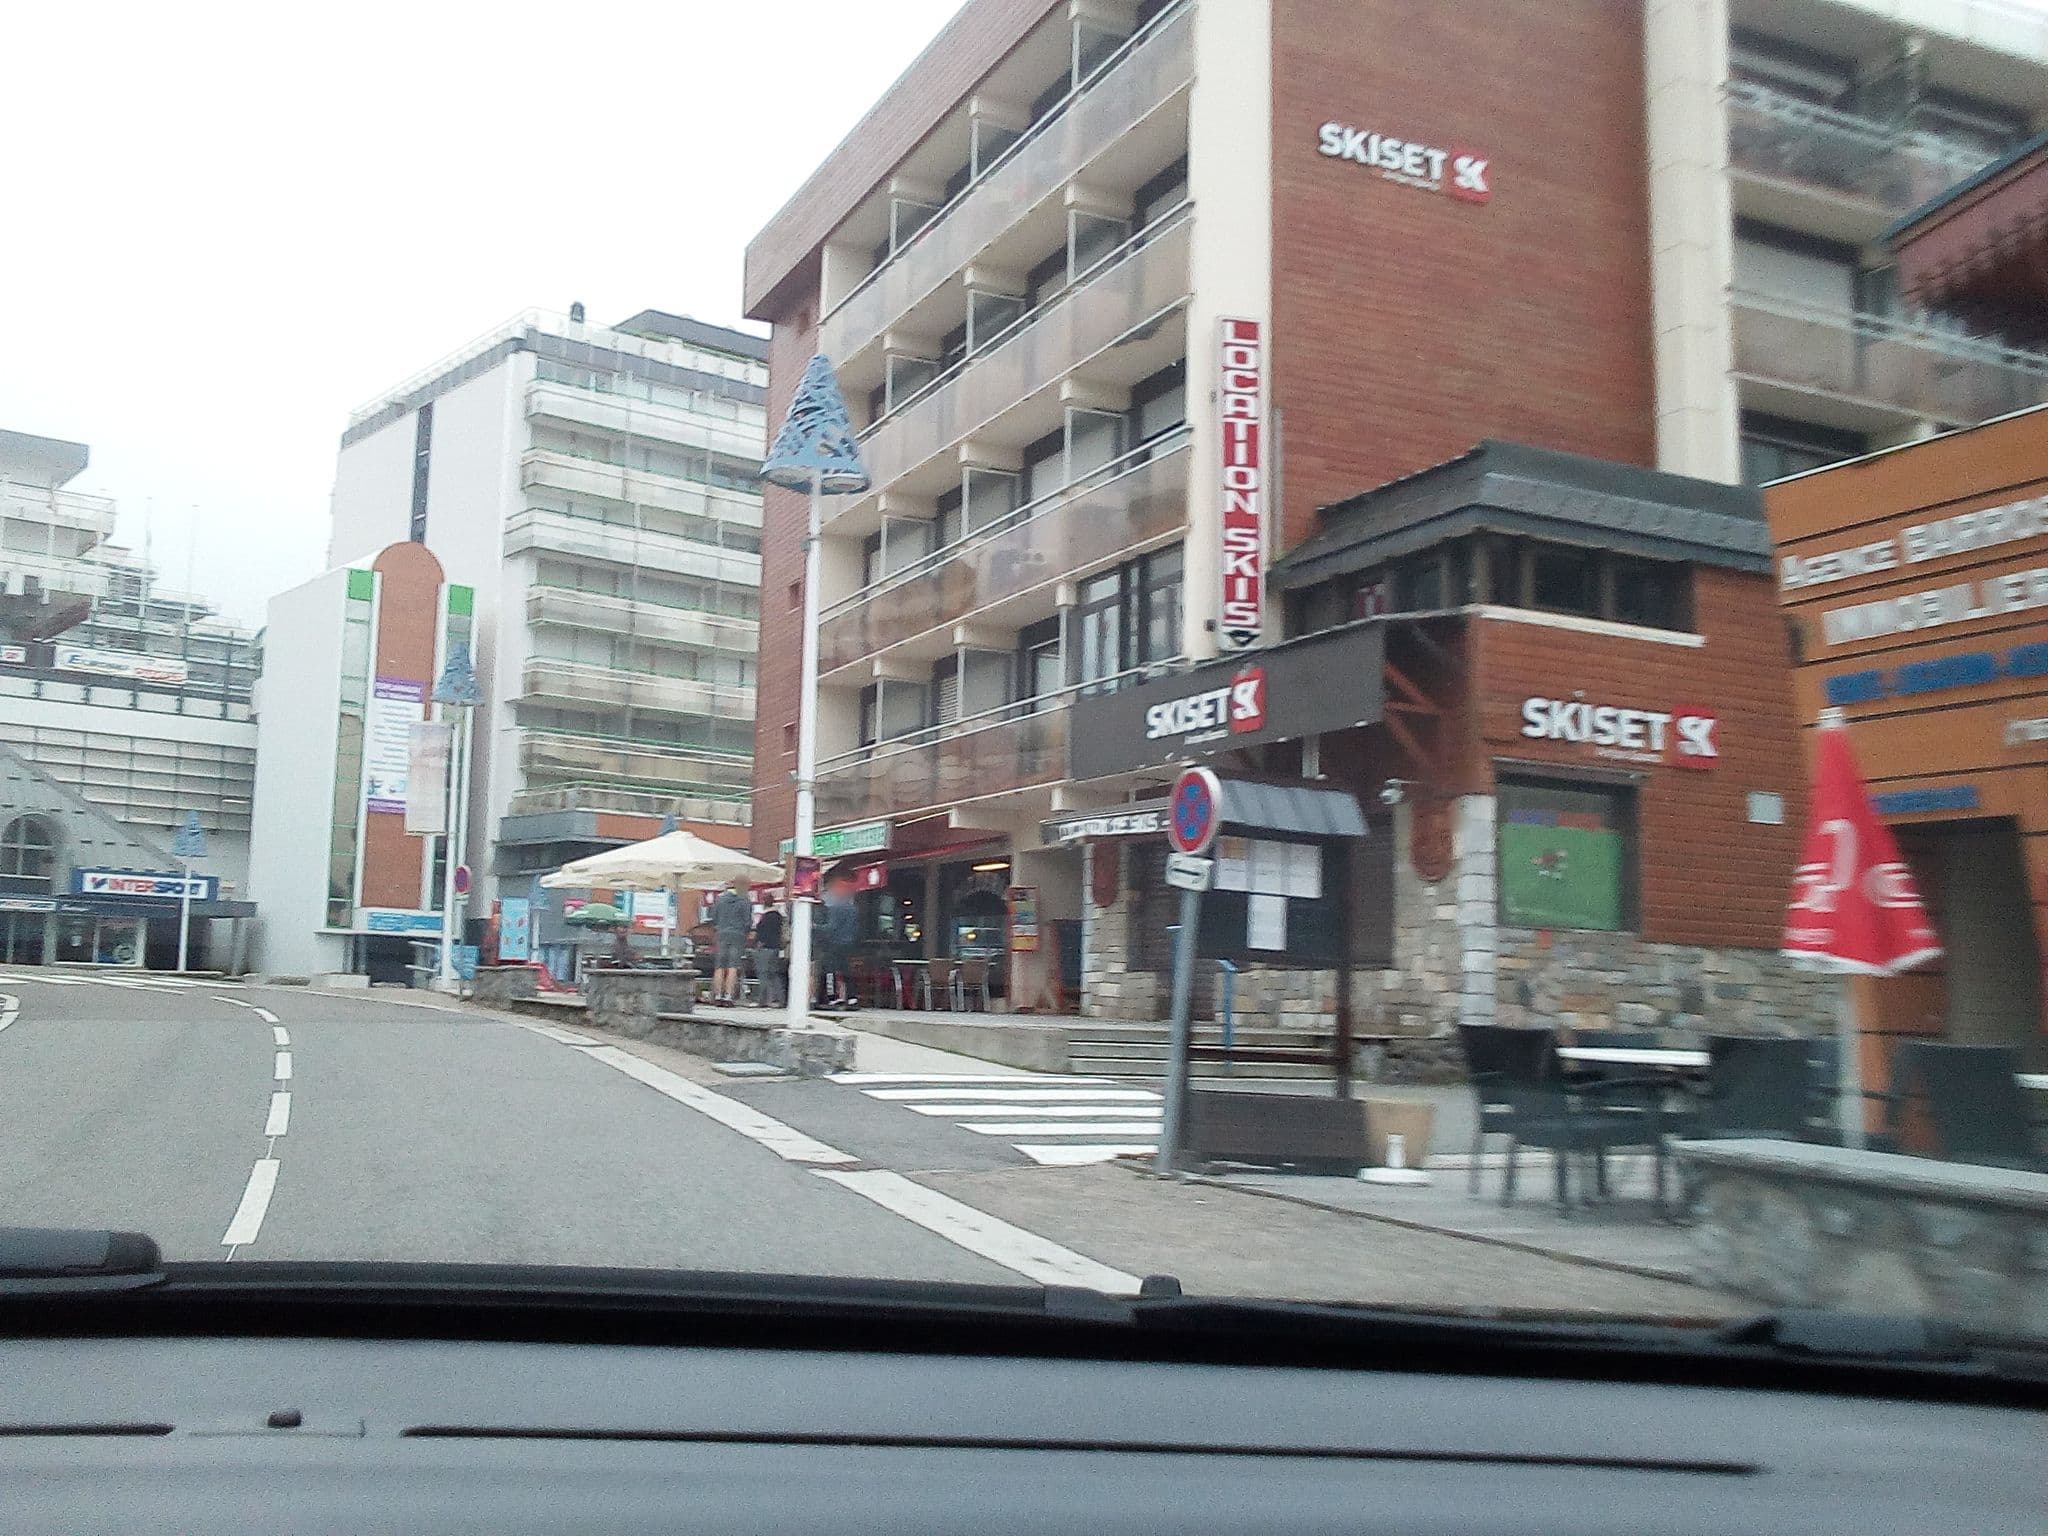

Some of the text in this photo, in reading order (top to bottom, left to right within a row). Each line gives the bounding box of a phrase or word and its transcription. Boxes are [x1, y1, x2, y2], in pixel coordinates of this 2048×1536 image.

[1318, 121, 1449, 181] SKISET
[1222, 318, 1259, 627] LOCATION SKIS
[1146, 686, 1232, 739] SKISET
[1520, 696, 1673, 751] SKISET
